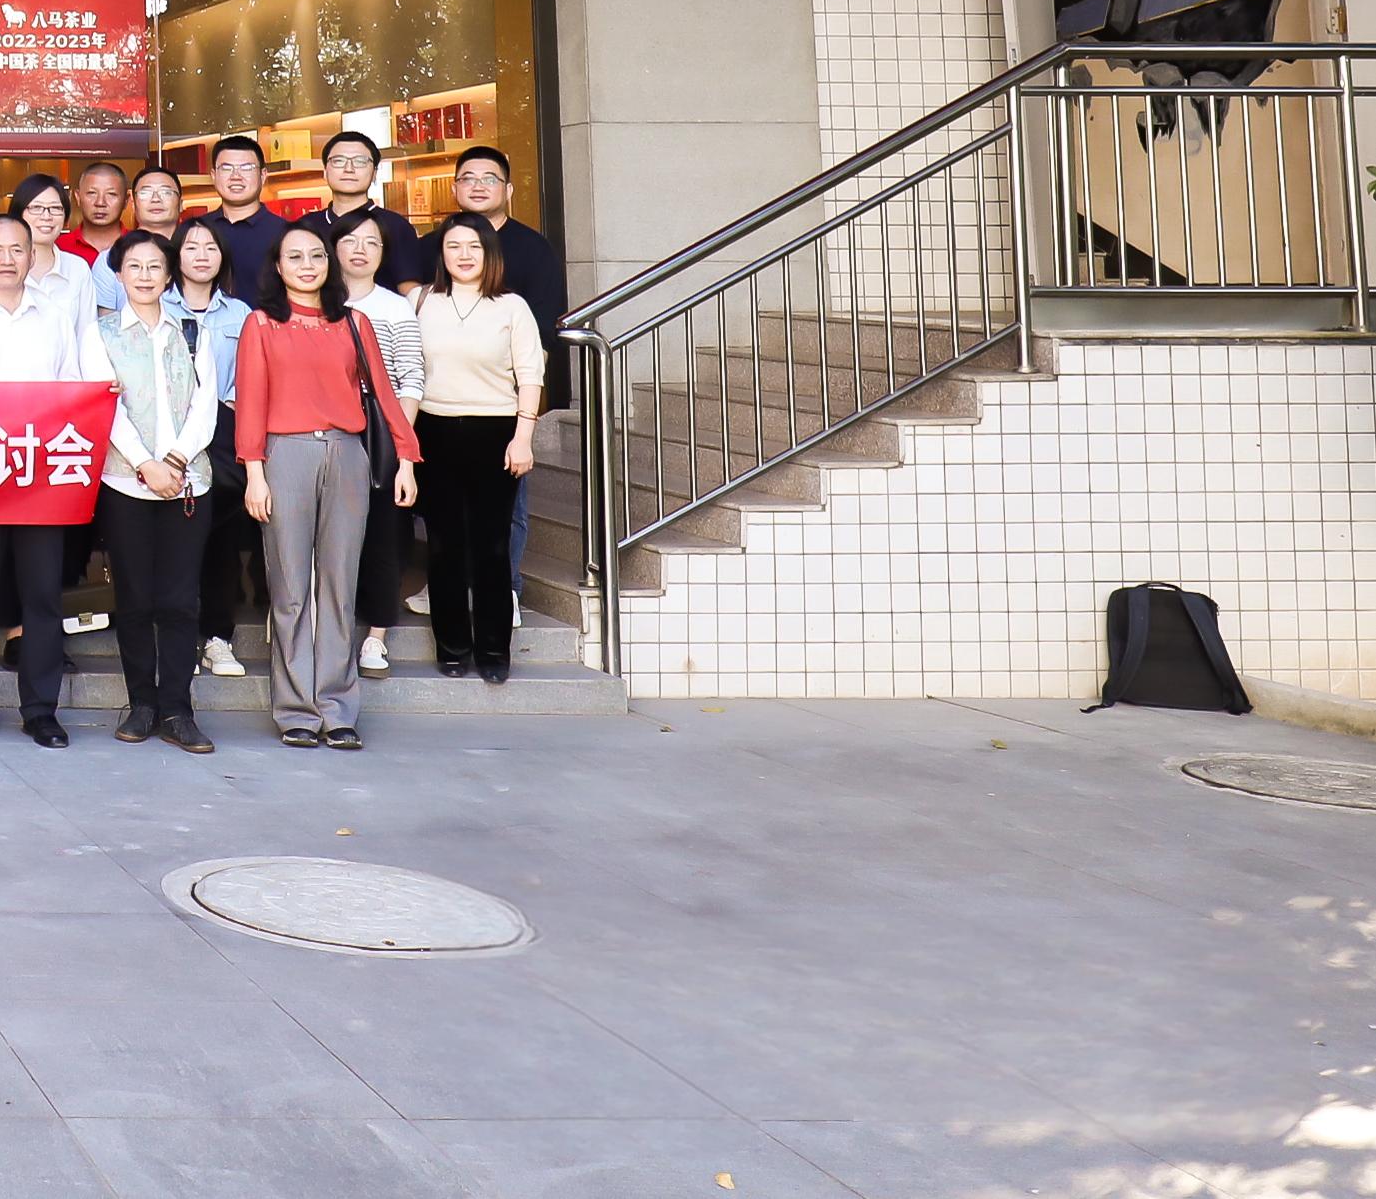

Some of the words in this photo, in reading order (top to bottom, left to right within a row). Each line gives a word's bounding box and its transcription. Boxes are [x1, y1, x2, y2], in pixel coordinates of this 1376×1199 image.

[31, 11, 97, 29] 八马茶业
[42, 52, 133, 71] 全国销量第一
